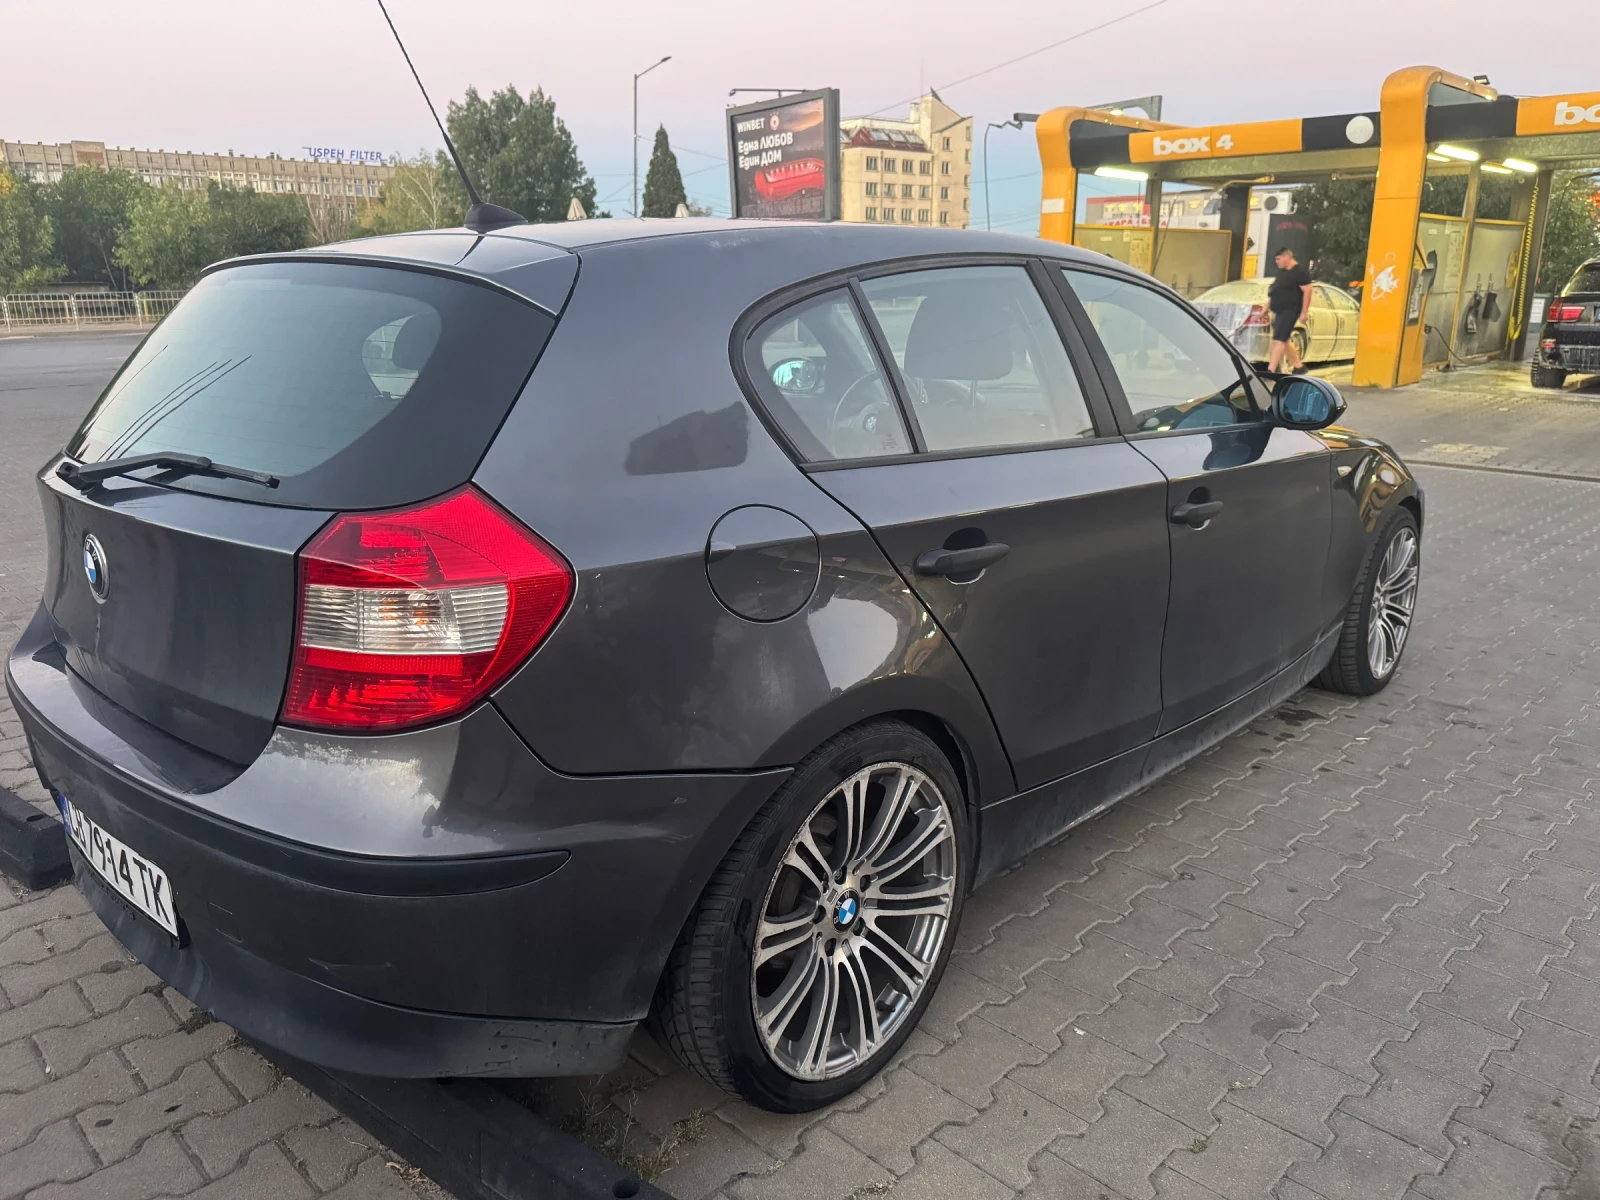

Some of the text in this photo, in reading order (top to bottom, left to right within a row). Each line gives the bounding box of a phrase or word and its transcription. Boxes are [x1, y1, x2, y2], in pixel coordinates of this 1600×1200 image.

[736, 118, 765, 133] WINBET
[738, 132, 793, 154] Една ЛЮБОВ
[1153, 134, 1235, 157] box 4
[309, 147, 382, 161] USPEH FILTER
[738, 150, 782, 171] Един ДОМ
[833, 891, 850, 924] BMW
